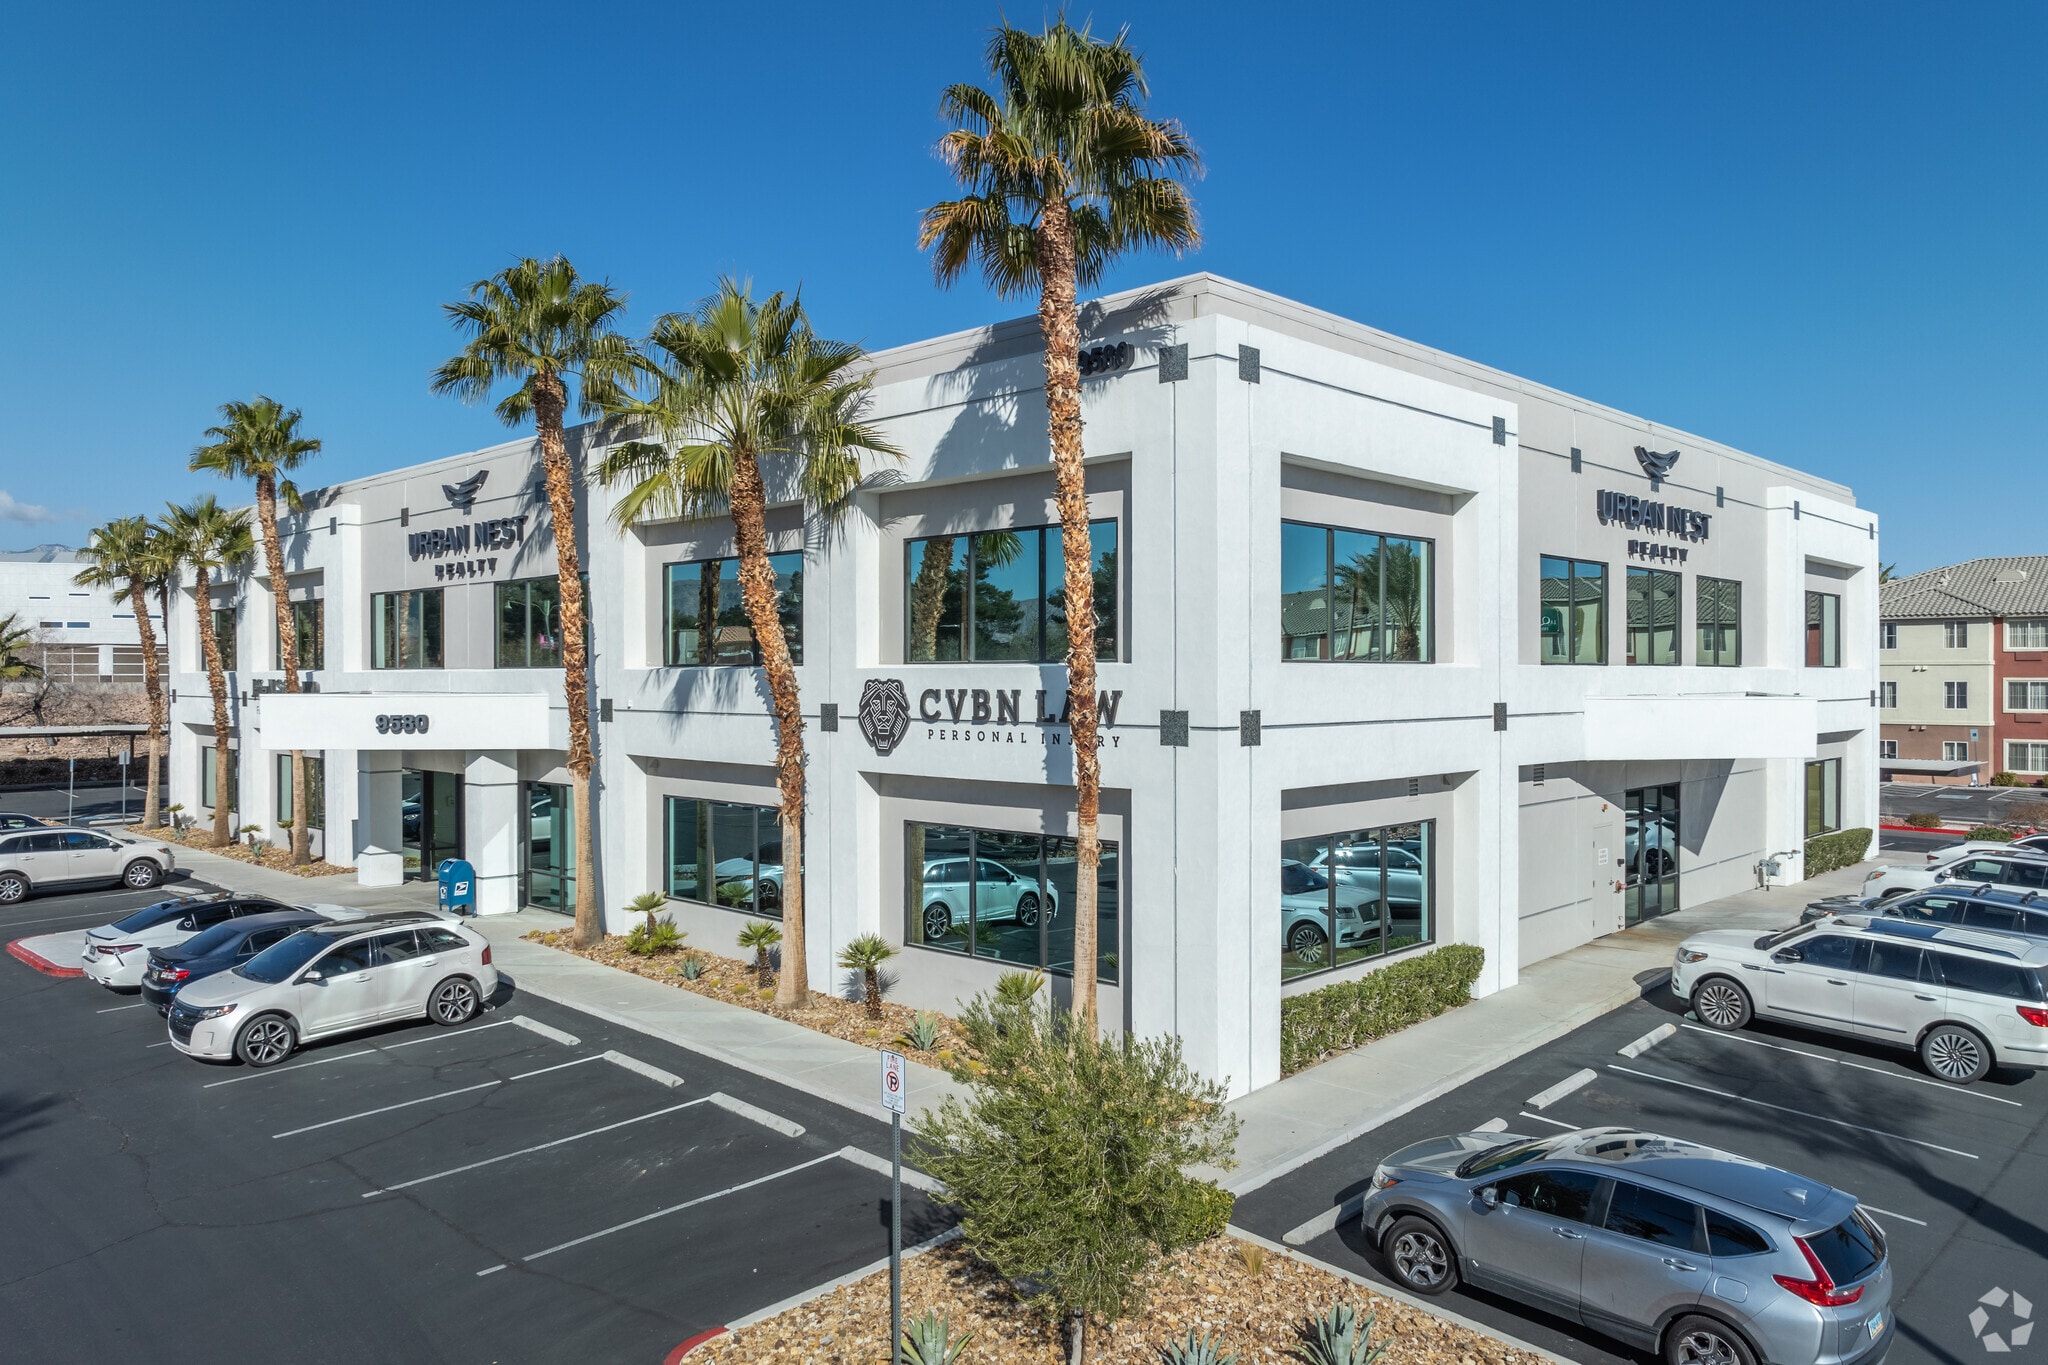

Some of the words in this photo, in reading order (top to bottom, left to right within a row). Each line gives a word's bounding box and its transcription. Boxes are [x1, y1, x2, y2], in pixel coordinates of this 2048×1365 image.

[1597, 489, 1665, 533] URBAN
[1667, 505, 1712, 543] NEST
[408, 524, 470, 560] URBAN
[474, 515, 529, 550] NEST
[1628, 540, 1688, 565] REALTY
[434, 557, 498, 580] REALTY
[920, 689, 1021, 726] CVBN
[375, 714, 430, 735] 9580
[928, 729, 1027, 743] PERSONAL
[1041, 733, 1120, 748] INJRY
